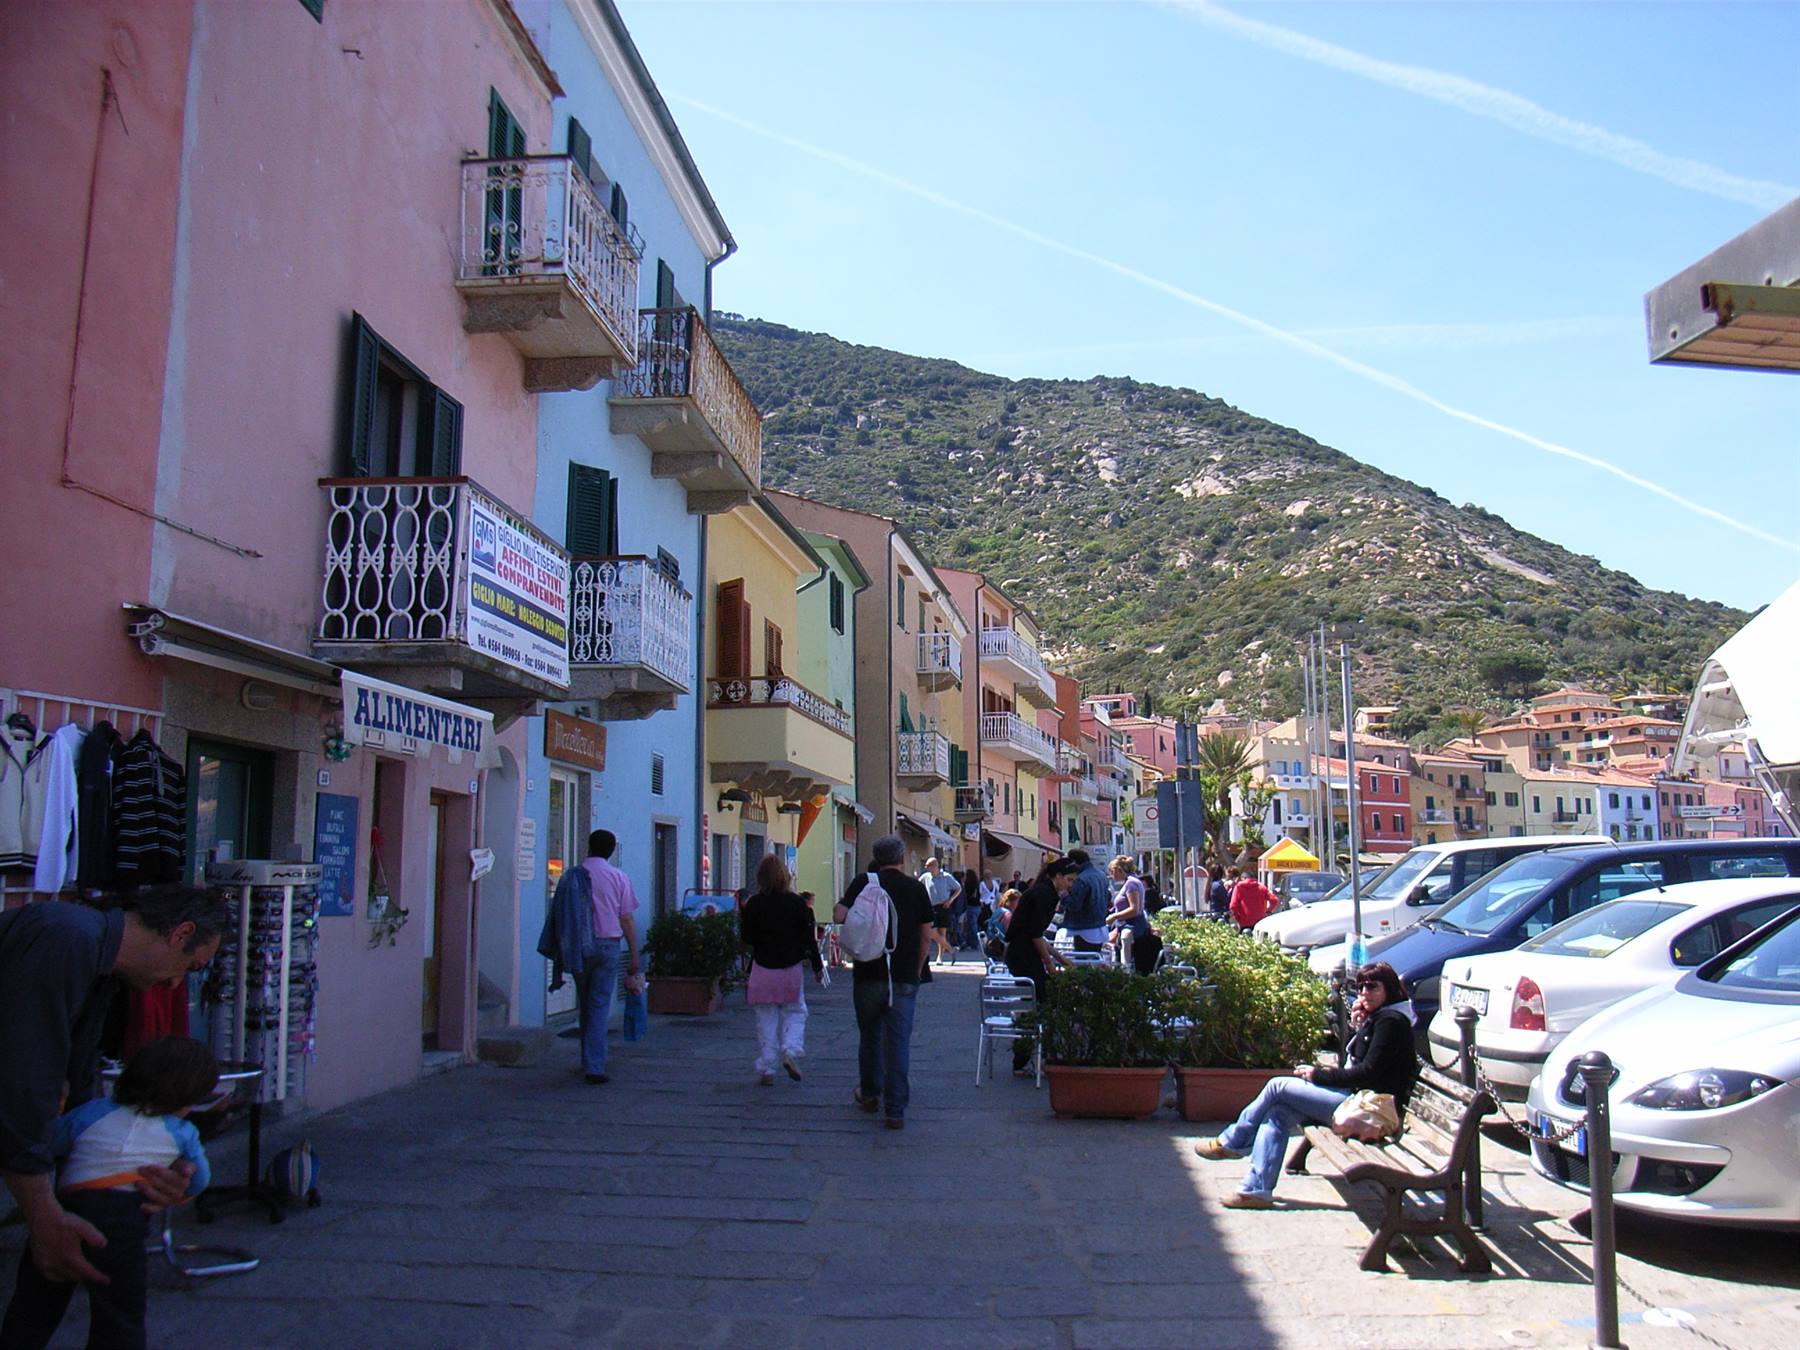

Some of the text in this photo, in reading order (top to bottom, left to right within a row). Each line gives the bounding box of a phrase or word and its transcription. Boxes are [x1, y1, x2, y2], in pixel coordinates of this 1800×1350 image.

[475, 520, 494, 546] GMS
[498, 526, 566, 581] GIGLIO MULTISERVIZI
[497, 561, 565, 613] COMPRAVENDITE
[502, 545, 562, 594] AFFITTI ESTIVI
[473, 582, 495, 607] GIGLIO
[519, 604, 544, 630] NOLEGGIO
[488, 639, 501, 654] 0564
[354, 687, 482, 753] ALIMENTARI
